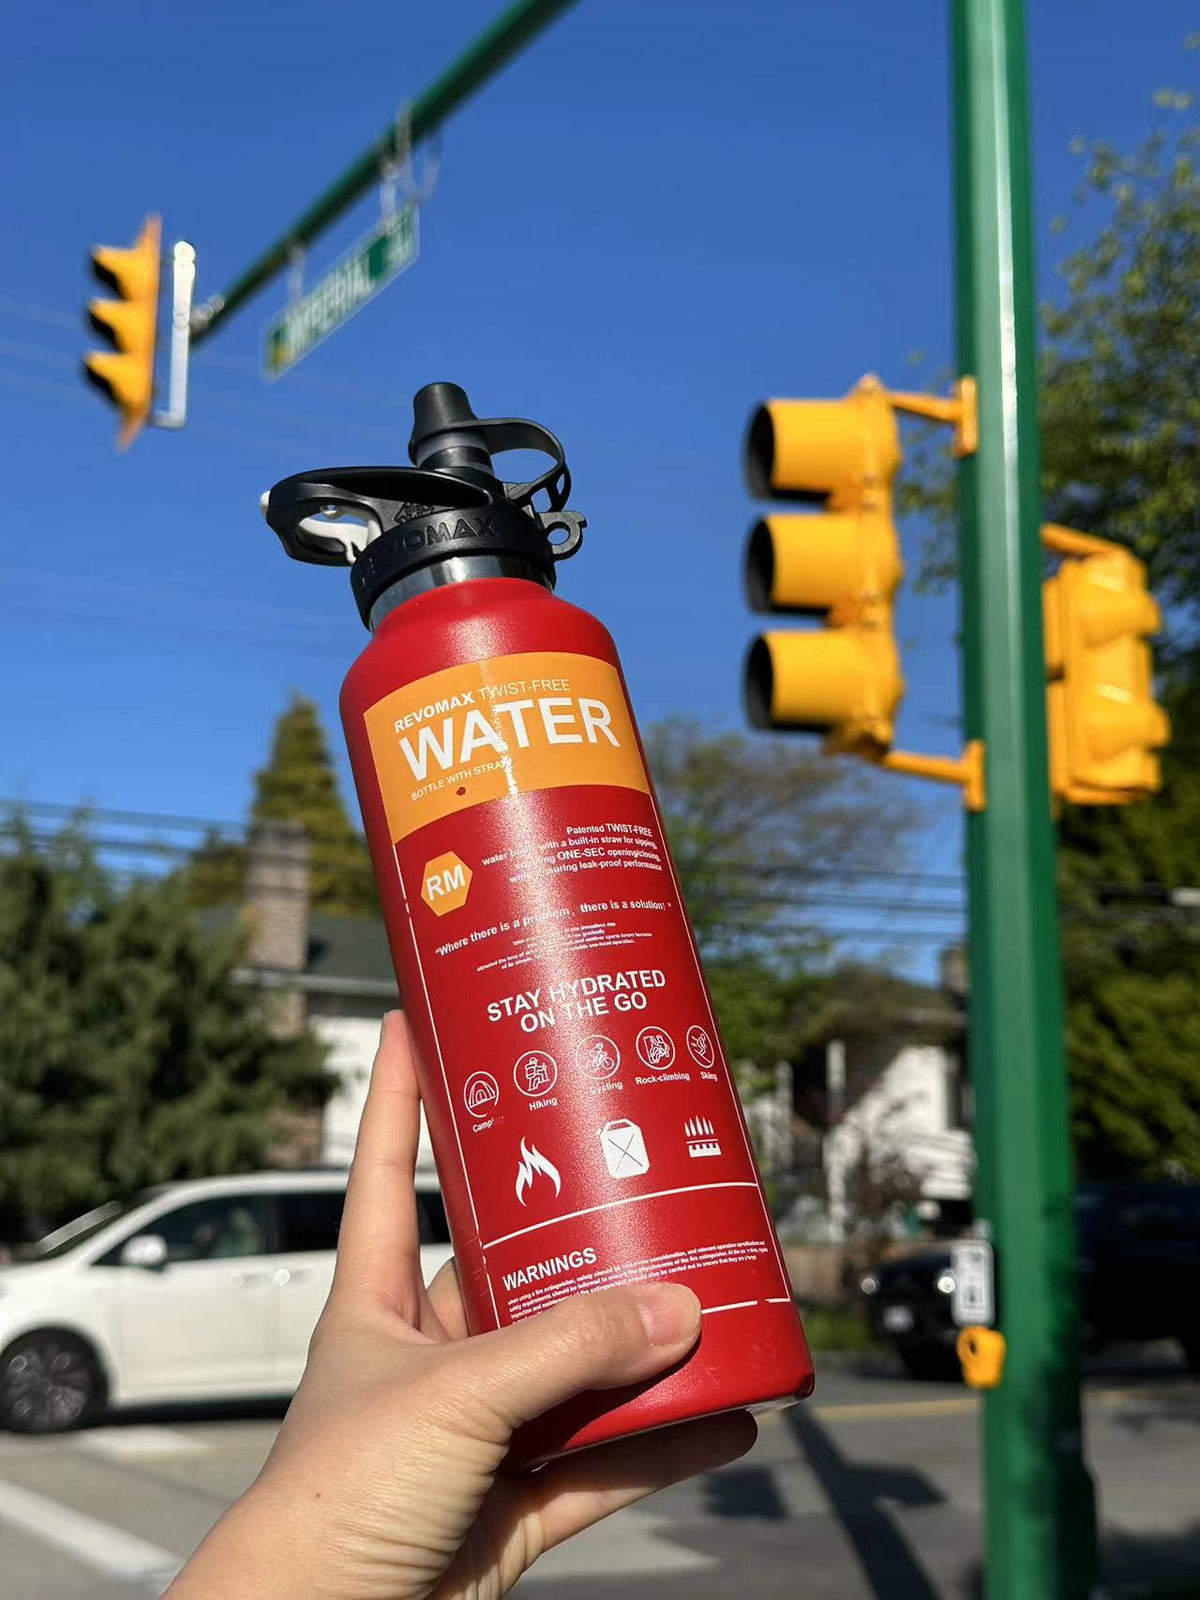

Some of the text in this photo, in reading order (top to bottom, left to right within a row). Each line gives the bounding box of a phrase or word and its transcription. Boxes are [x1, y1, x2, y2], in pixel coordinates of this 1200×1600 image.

[394, 678, 571, 734] REVOMAX TWIST-FREE
[398, 696, 621, 782] WATER
[411, 779, 446, 802] BOTTLE
[446, 770, 472, 785] WITH
[566, 822, 654, 838] Patented TWIST-FREE
[481, 852, 509, 866] water
[560, 840, 567, 848] a
[568, 836, 600, 847] built-in
[601, 836, 623, 845] straw
[623, 834, 634, 845] for
[556, 847, 606, 861] ONE-SEC
[579, 858, 622, 870] leak-proof
[426, 863, 466, 901] RM
[470, 926, 498, 944] there
[499, 920, 511, 933] is
[513, 920, 520, 929] a
[580, 901, 608, 914] there
[609, 899, 620, 910] is
[622, 900, 629, 909] a
[486, 969, 666, 1022] STAY HYDRATED
[520, 991, 648, 1033] ON THE GO
[635, 1072, 691, 1086] Rock-climbing
[529, 1096, 559, 1111] Hiking
[502, 1247, 597, 1291] WARNINGS
